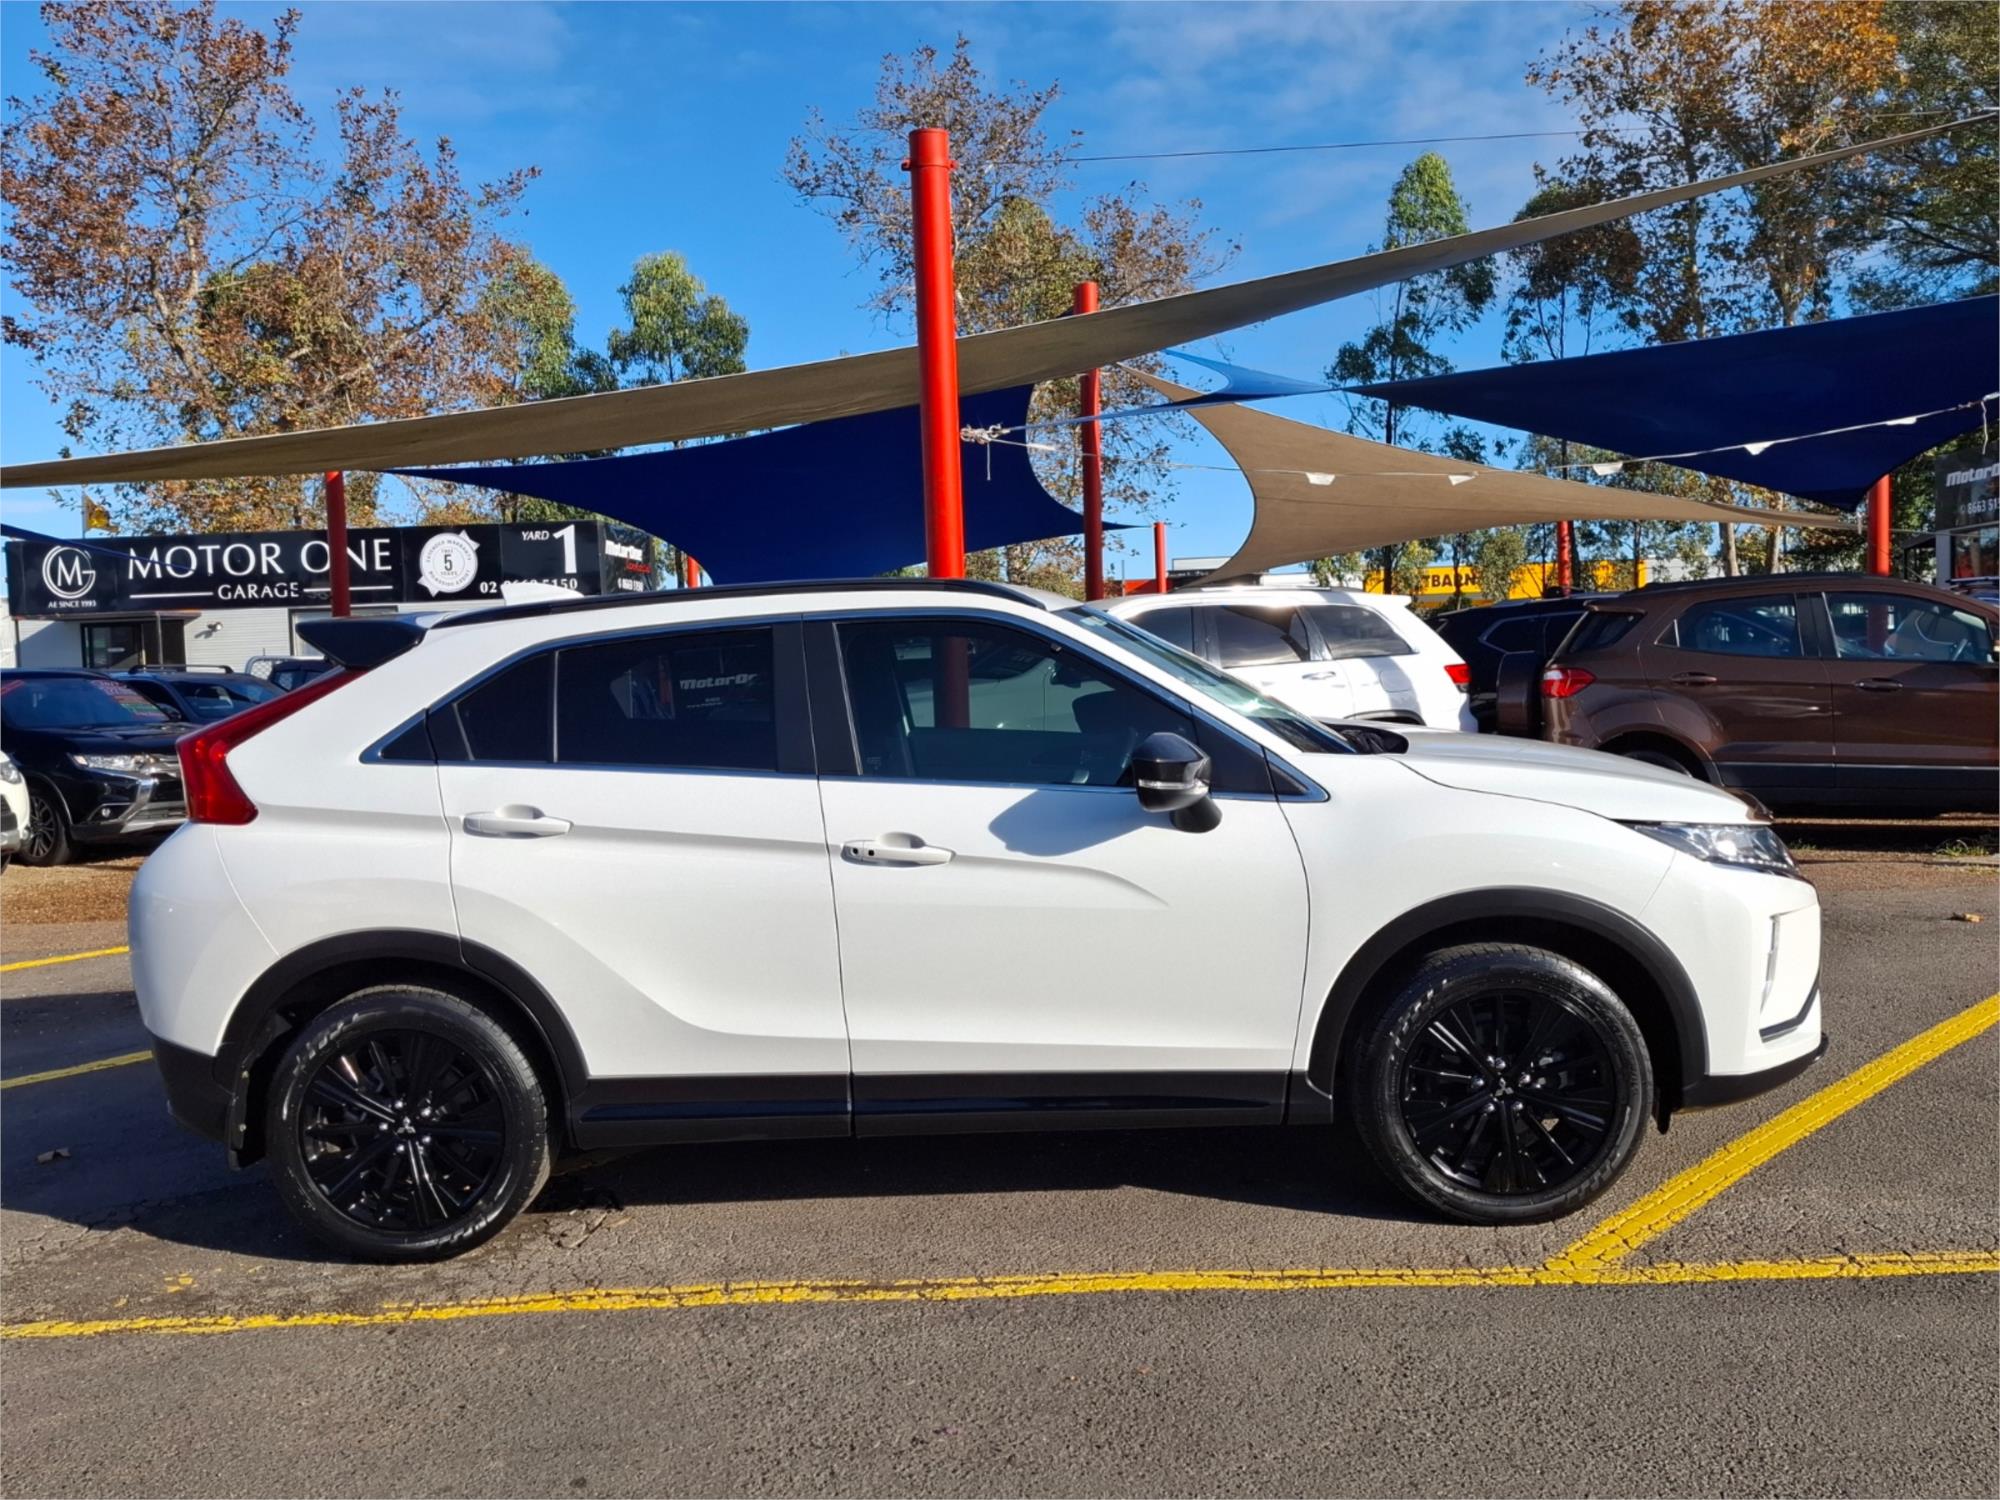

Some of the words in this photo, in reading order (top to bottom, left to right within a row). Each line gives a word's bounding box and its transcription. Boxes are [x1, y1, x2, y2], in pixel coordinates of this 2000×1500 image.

[521, 530, 550, 541] YARD
[552, 524, 577, 574] 1
[128, 543, 285, 580] MOTOR
[300, 538, 392, 573] ONE
[444, 553, 453, 571] 5
[218, 582, 299, 600] GARAGE
[480, 581, 497, 594] 02
